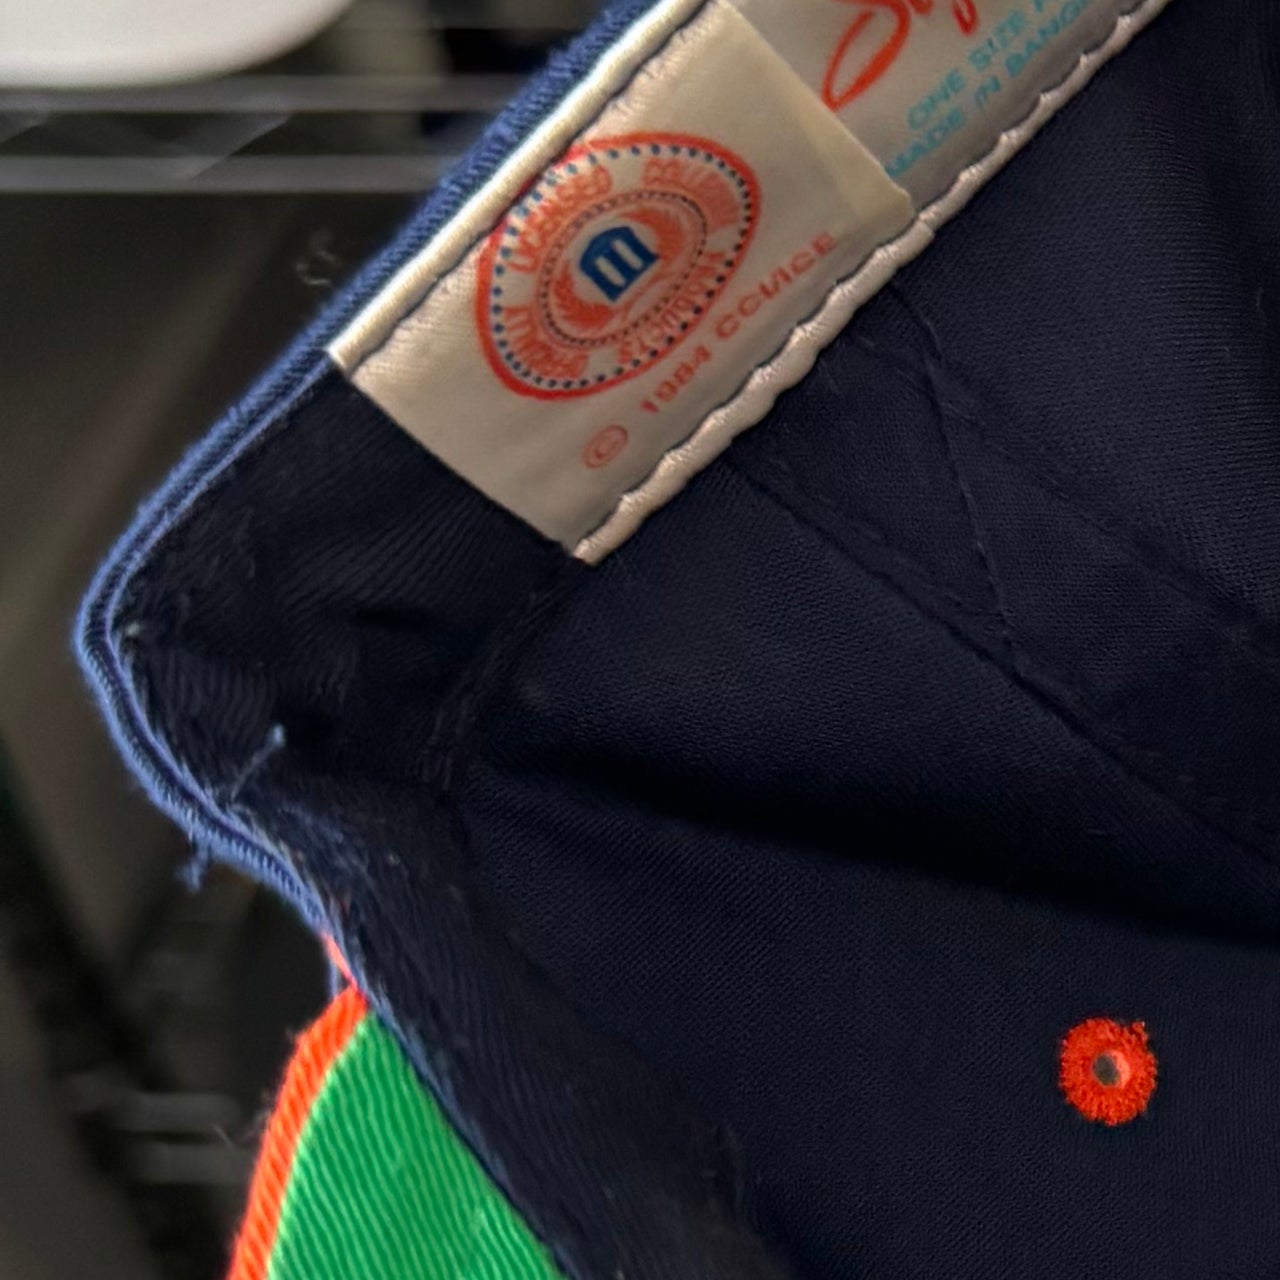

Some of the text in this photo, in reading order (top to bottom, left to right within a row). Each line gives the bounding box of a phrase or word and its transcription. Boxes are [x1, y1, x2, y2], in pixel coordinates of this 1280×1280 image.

[906, 67, 967, 131] ONE
[968, 8, 1027, 72] SIZE
[884, 106, 966, 180] MADE
[974, 75, 1002, 111] IN
[639, 342, 712, 414] 1984
